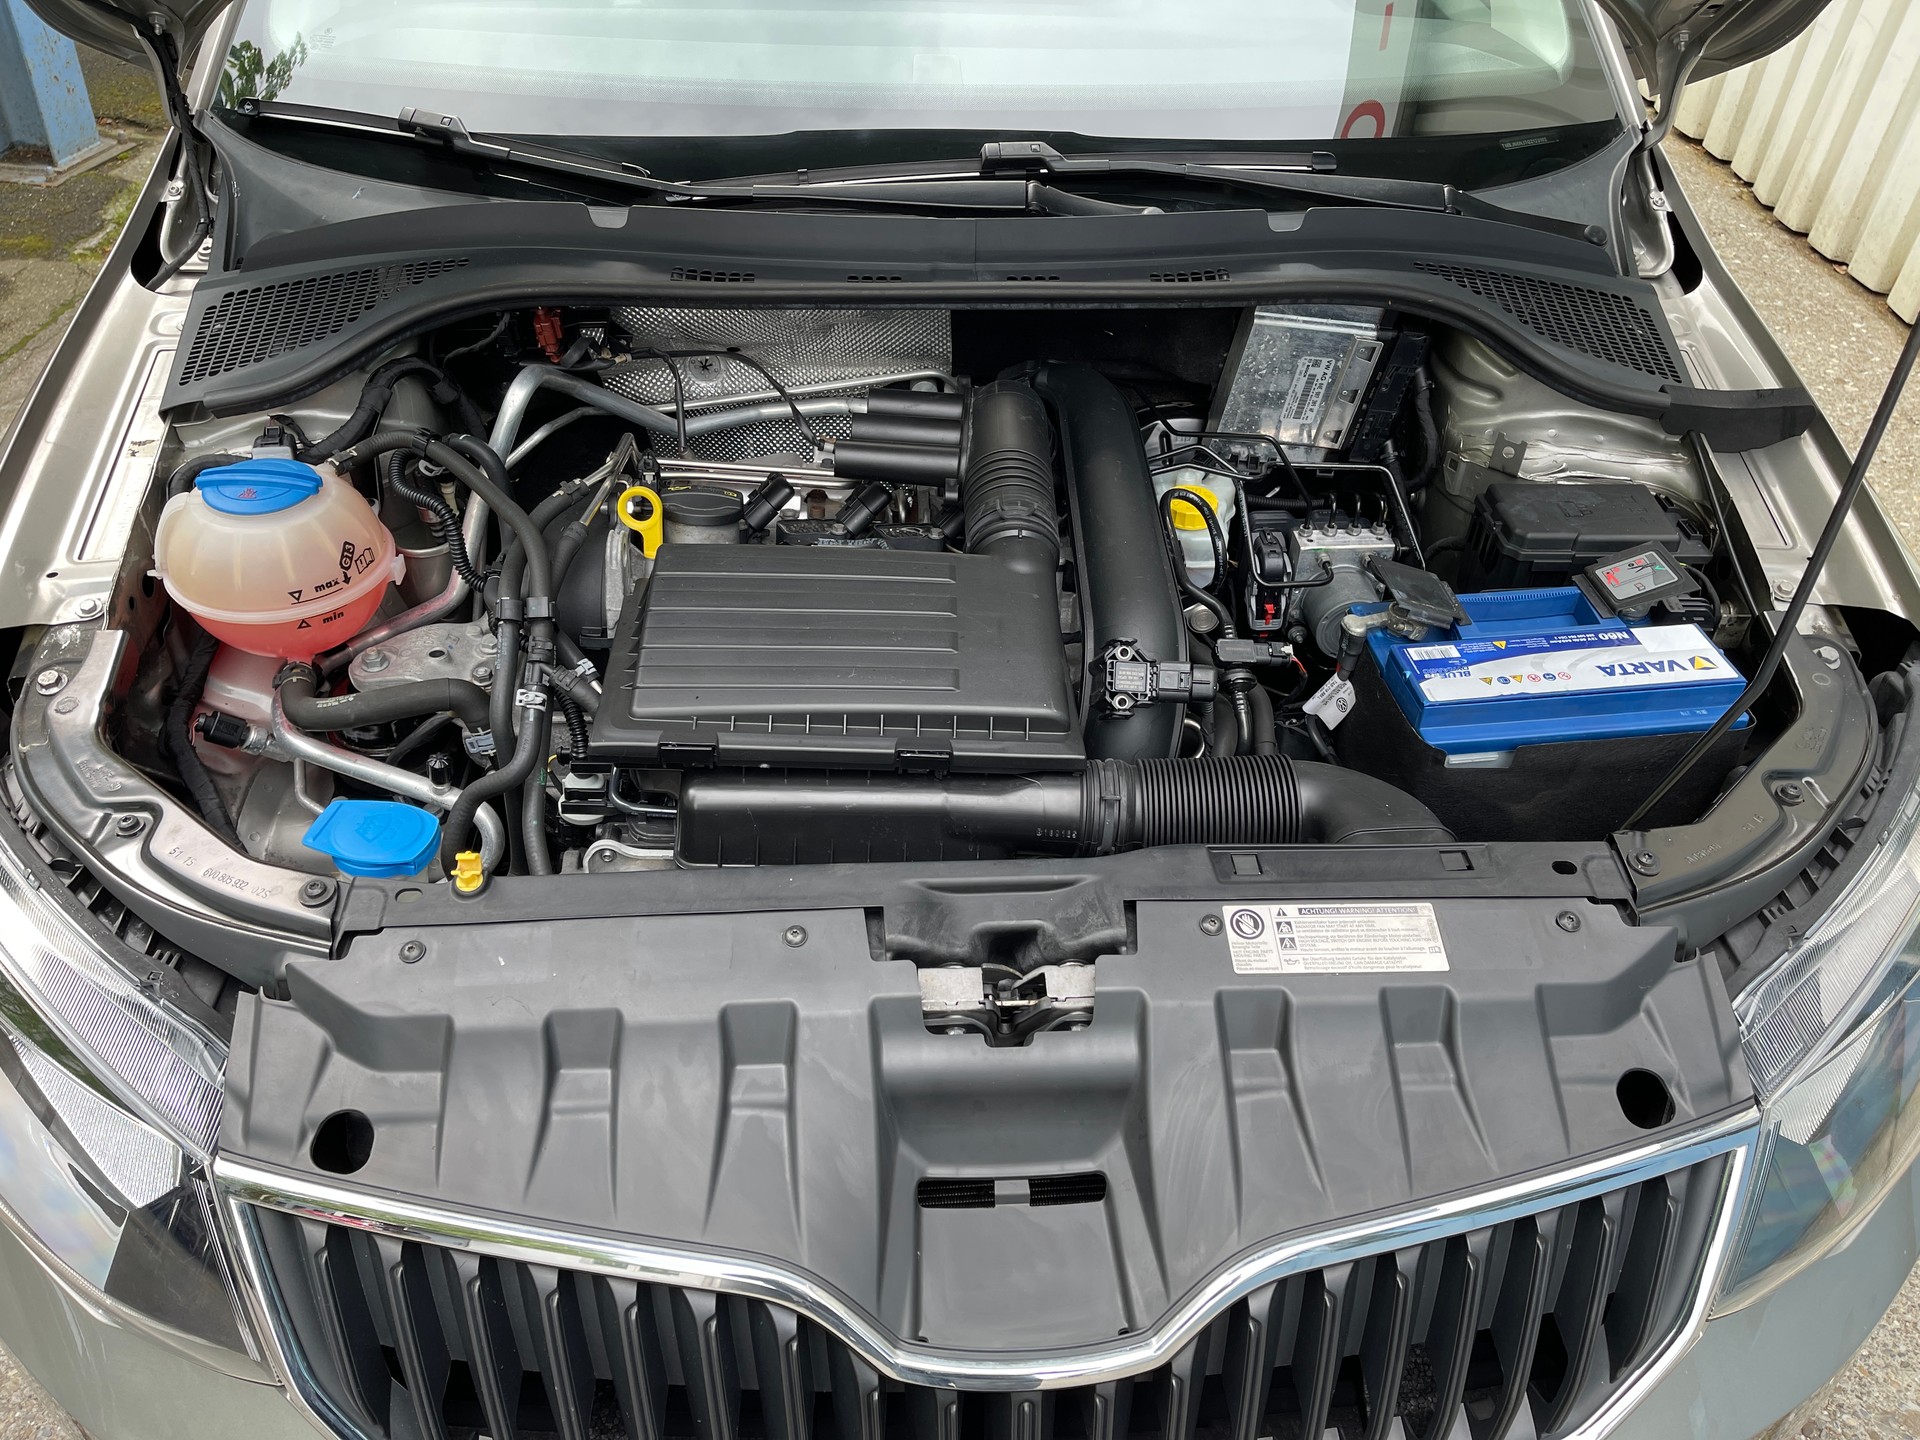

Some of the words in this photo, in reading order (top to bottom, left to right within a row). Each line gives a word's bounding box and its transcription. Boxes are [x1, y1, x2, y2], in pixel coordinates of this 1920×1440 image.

[341, 544, 354, 567] G13
[314, 578, 340, 592] max
[322, 611, 345, 624] min
[1598, 631, 1630, 641] N60
[1442, 670, 1471, 678] BLUE
[1595, 658, 1689, 677] VARTA
